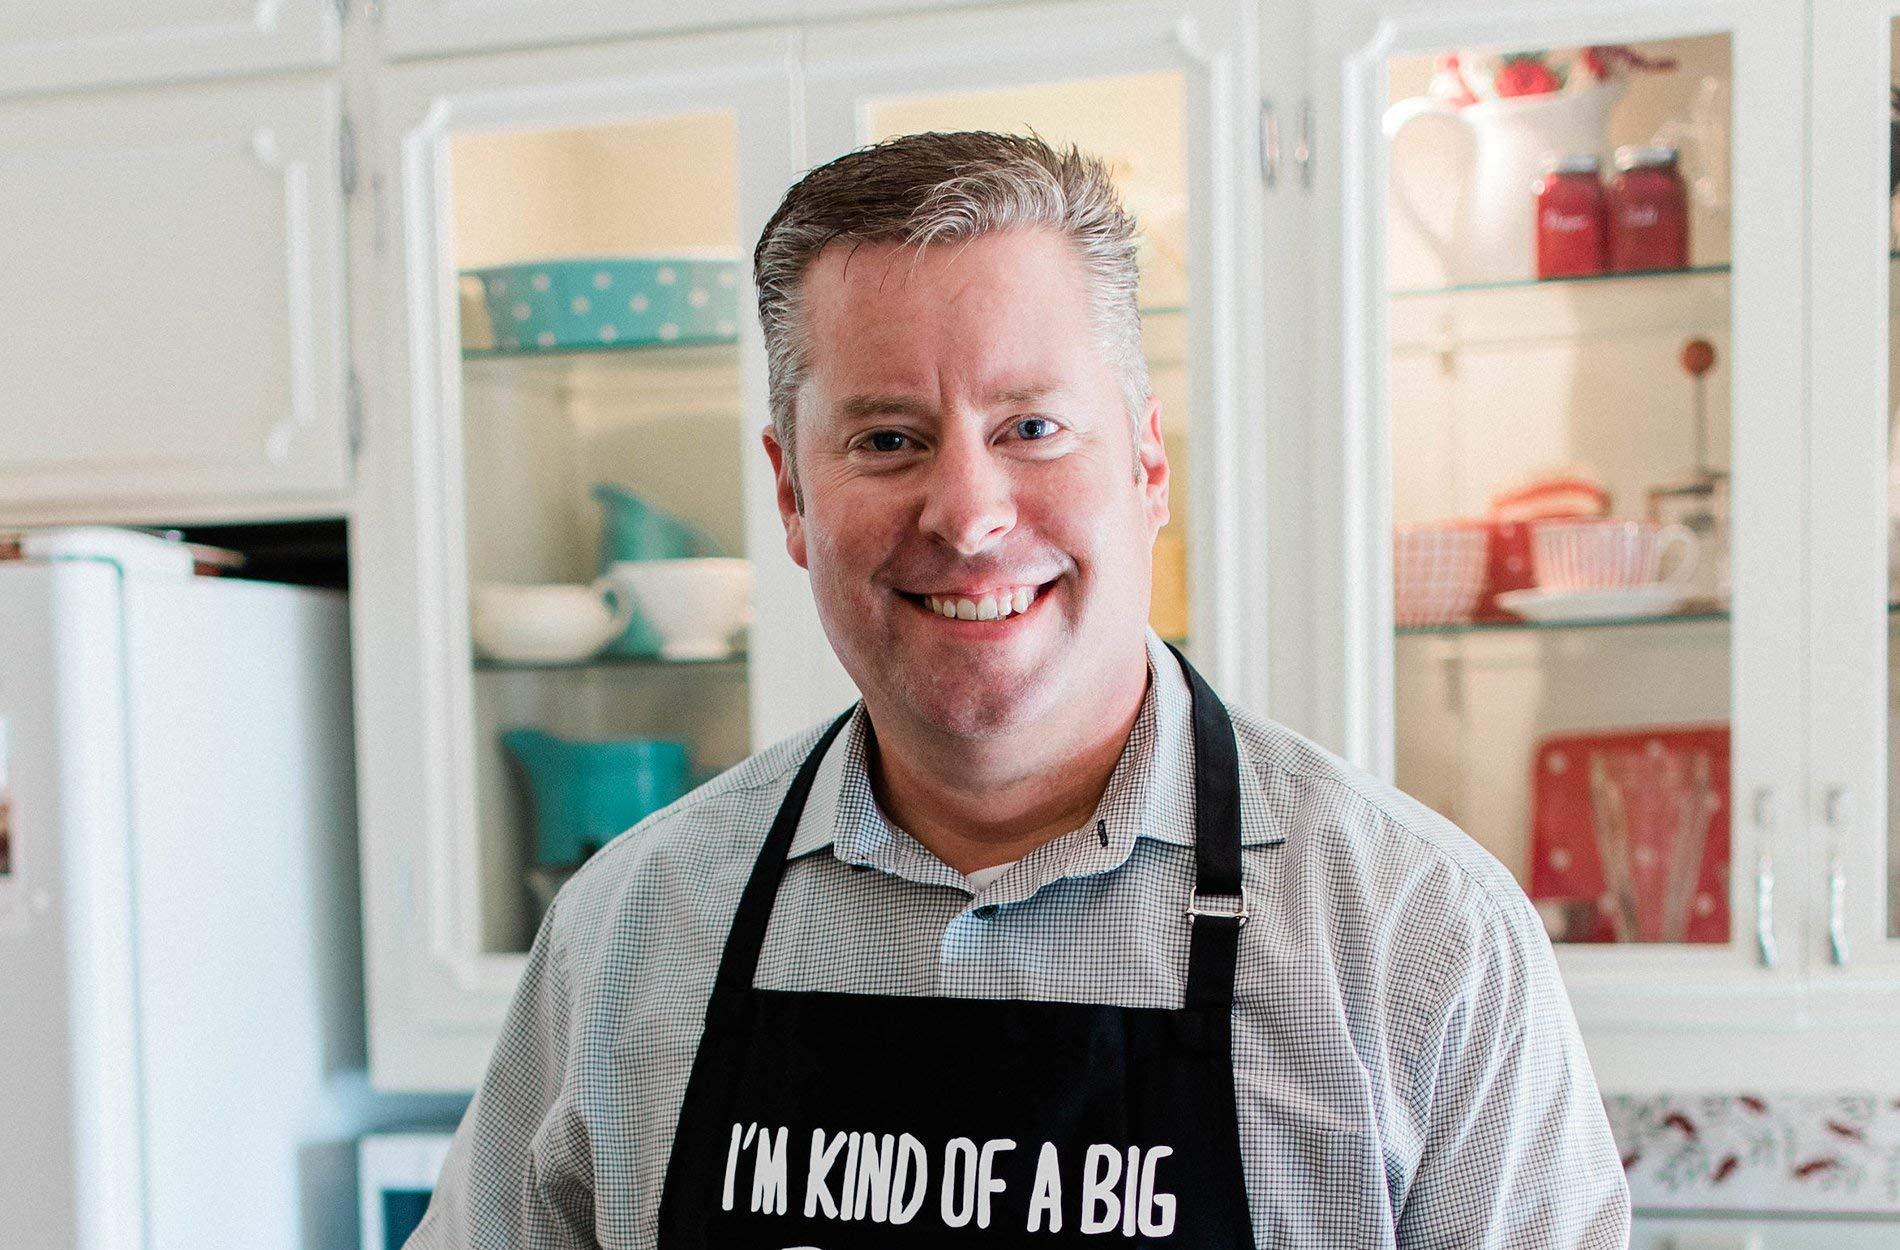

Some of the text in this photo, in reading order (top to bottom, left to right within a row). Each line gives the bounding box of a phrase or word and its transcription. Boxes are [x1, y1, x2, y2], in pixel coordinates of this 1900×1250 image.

[721, 1121, 1177, 1238] I'M KIND OF A BIG
